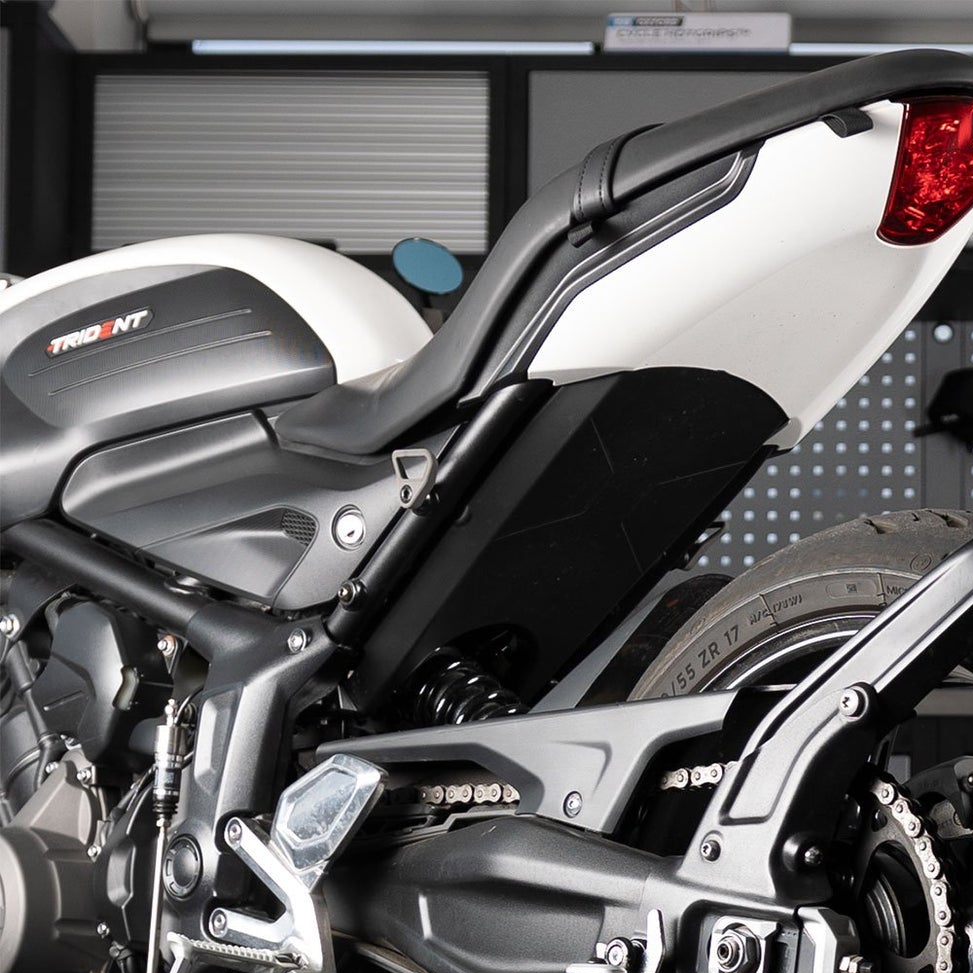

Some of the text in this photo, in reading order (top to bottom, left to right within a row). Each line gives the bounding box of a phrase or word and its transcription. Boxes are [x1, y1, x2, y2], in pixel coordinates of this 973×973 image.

[48, 310, 148, 354] TRIDENT
[697, 641, 720, 668] ZR
[724, 624, 740, 647] 17
